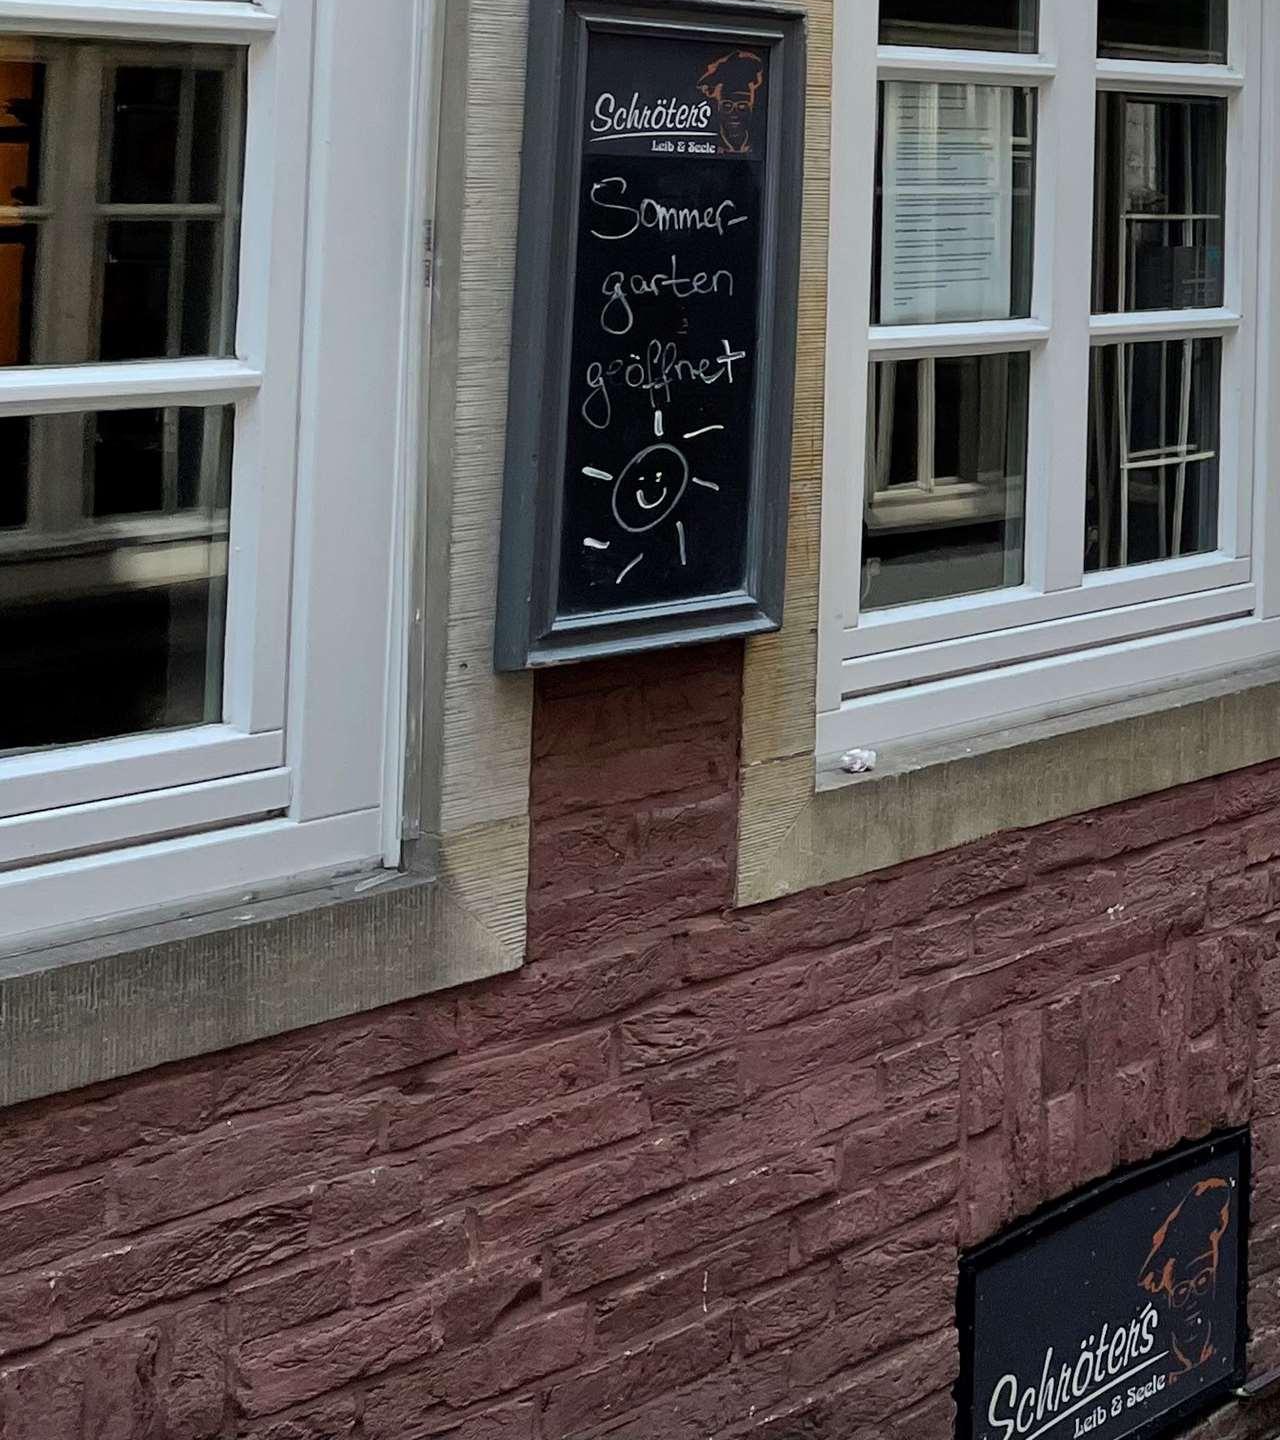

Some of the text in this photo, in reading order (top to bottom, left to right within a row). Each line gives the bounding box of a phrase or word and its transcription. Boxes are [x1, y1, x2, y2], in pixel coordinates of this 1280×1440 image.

[651, 140, 715, 153] Leib & Seele
[601, 254, 734, 335] garten
[582, 339, 746, 429] geöffnet
[1073, 1373, 1166, 1440] Leib & Seele
